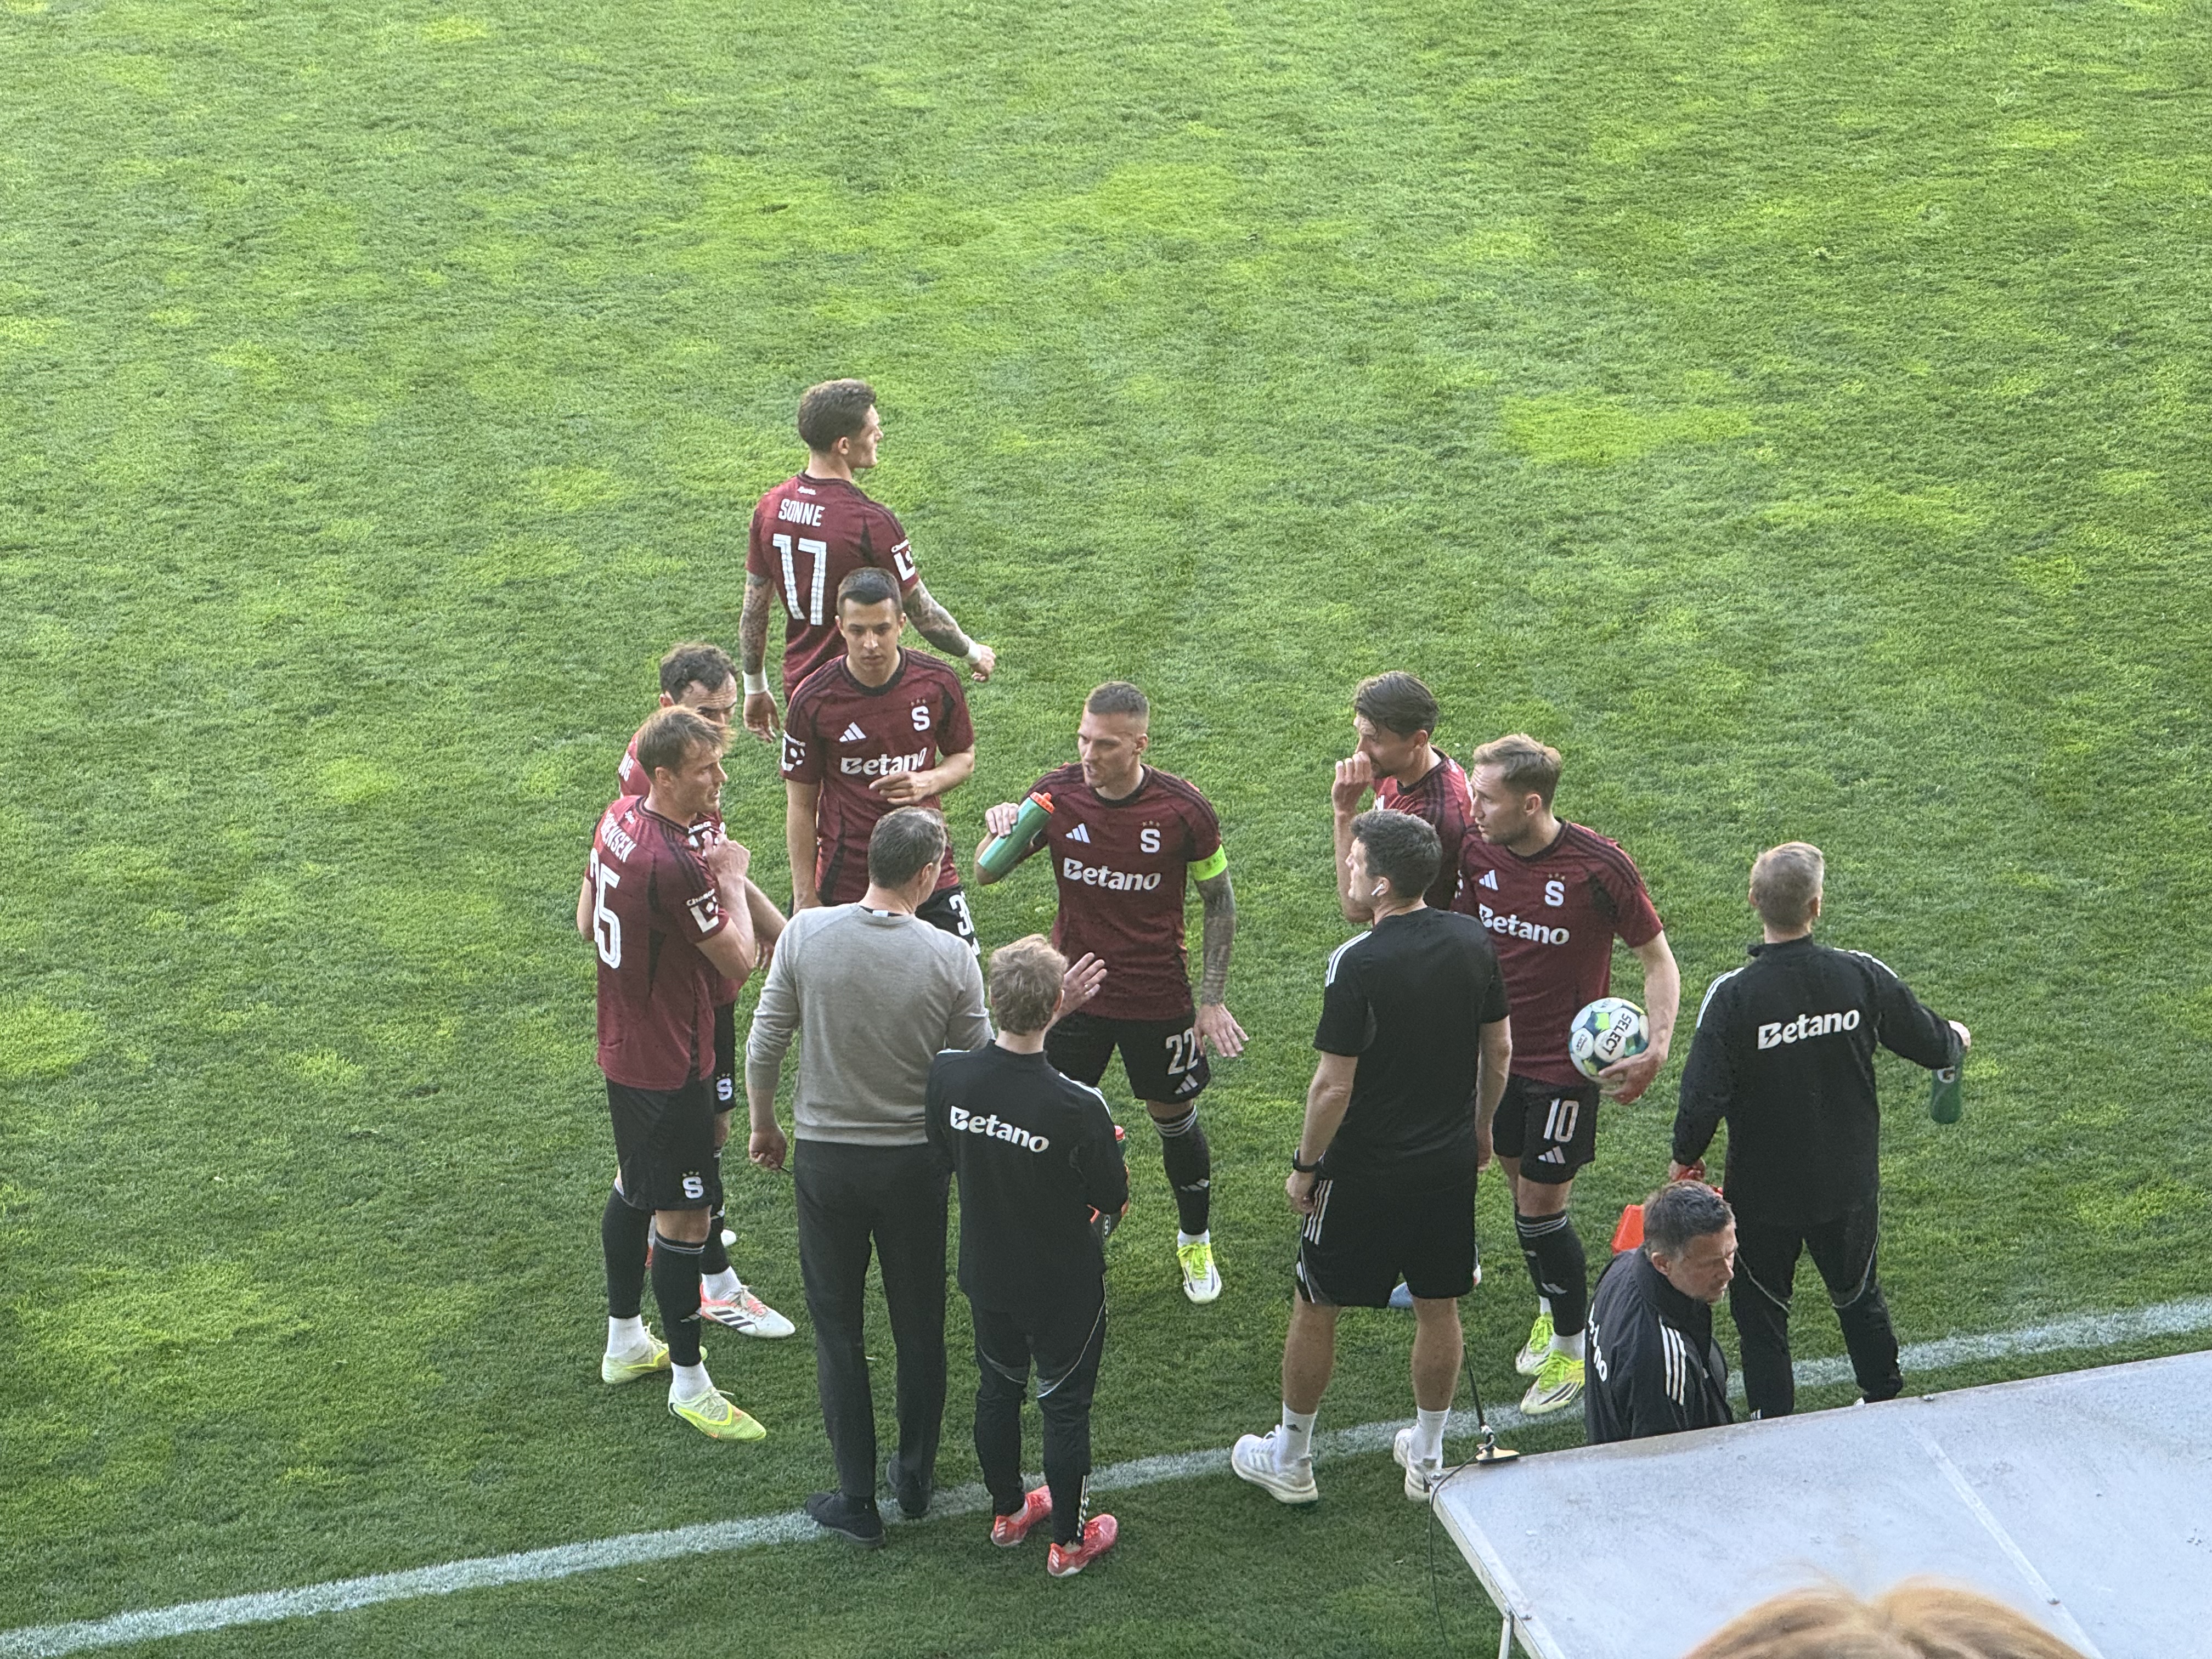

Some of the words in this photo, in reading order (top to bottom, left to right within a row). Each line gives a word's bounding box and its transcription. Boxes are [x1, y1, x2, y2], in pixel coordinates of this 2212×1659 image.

[778, 498, 826, 527] SONNE
[772, 533, 827, 626] 17
[911, 706, 930, 731] S
[840, 747, 927, 776] Betano
[1141, 828, 1160, 853] S
[1063, 857, 1161, 891] Betano
[1544, 880, 1565, 907] S
[1479, 902, 1570, 945] Betano
[1602, 1013, 1633, 1057] SELECT
[1757, 1009, 1860, 1050] Betano
[1165, 1027, 1198, 1075] 22
[716, 1077, 733, 1101] S
[949, 1105, 1050, 1153] Betano
[1543, 1098, 1579, 1143] 10
[682, 1176, 704, 1199] S
